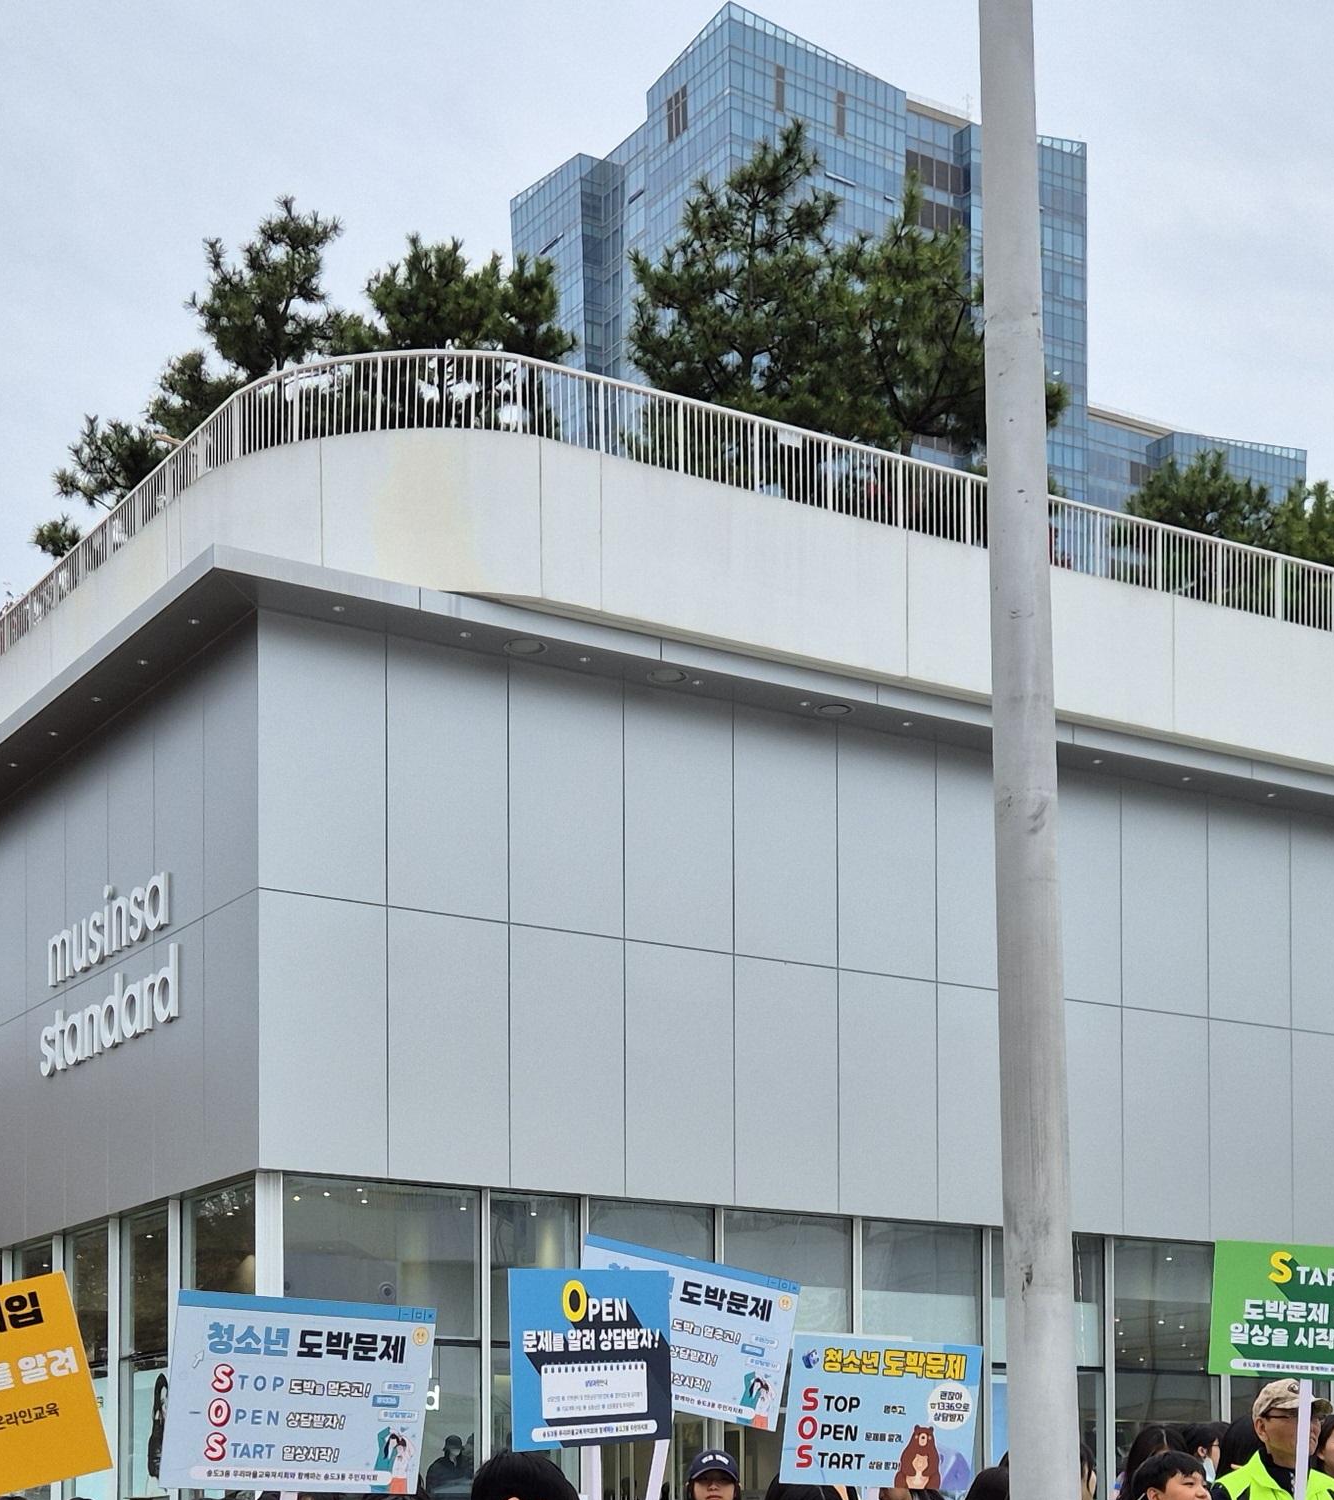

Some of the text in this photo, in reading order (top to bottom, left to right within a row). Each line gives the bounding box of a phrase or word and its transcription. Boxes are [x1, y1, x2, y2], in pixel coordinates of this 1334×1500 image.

[48, 871, 169, 987] musinsa
[40, 942, 180, 1077] standard
[562, 1279, 628, 1322] OPEN
[680, 1280, 773, 1323] 도박문제
[1243, 1299, 1329, 1325] 도박문제
[207, 1322, 407, 1364] 청소년 도박문제
[522, 1328, 660, 1353] 문제를 알려 상담받자!
[1230, 1323, 1289, 1347] 일상을
[17, 1347, 79, 1385] 알려
[211, 1363, 285, 1394] STOP
[326, 1380, 372, 1398] 멈추고!
[823, 1347, 967, 1381] 청소년 도박문제
[207, 1397, 346, 1430] OPEN 상담받자!
[204, 1431, 340, 1463] START 일상시작!
